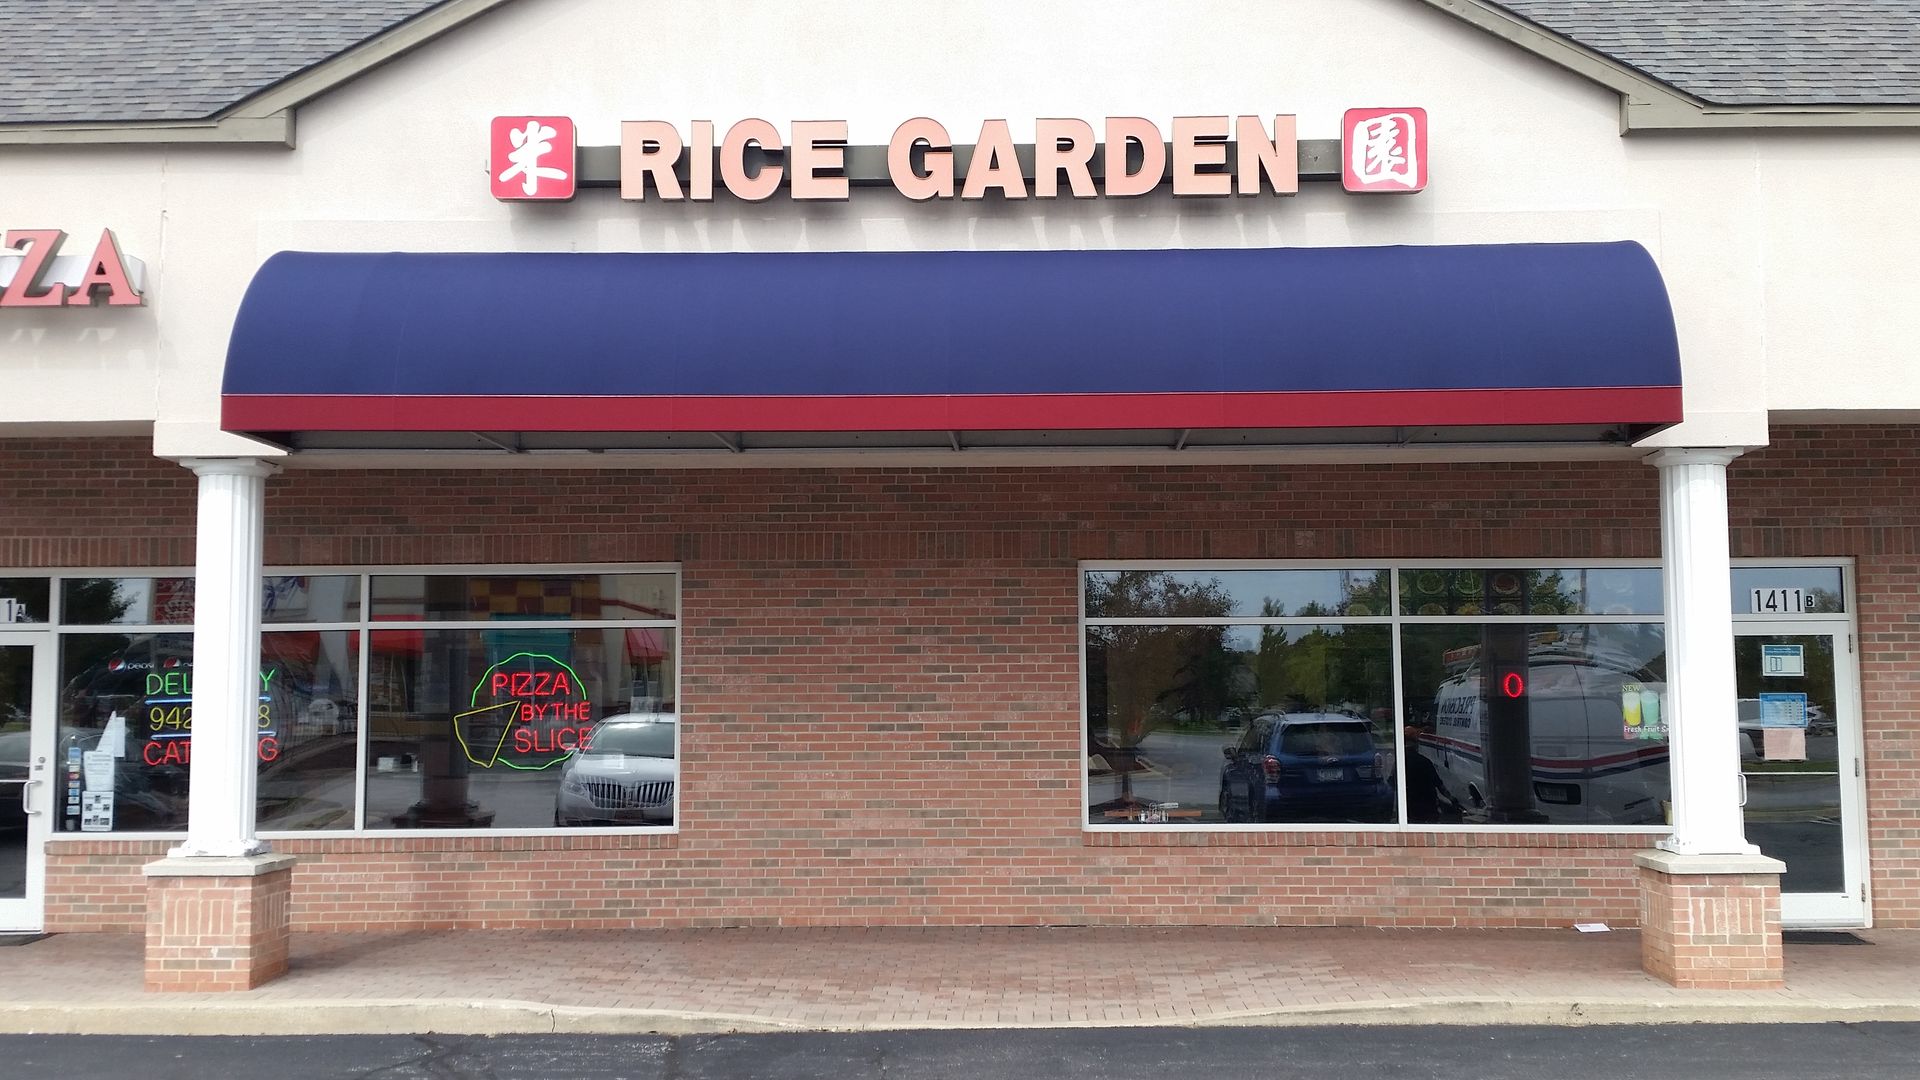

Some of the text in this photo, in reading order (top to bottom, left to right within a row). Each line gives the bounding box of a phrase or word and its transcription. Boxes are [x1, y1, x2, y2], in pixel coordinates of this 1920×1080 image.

[499, 120, 568, 197] 米
[620, 114, 1299, 201] RICE GARDEN
[0, 227, 143, 307] ZA
[1754, 589, 1814, 612] 1411 B
[145, 669, 276, 696] DELY
[492, 672, 570, 697] PIZZA
[1622, 684, 1641, 692] NEW
[521, 701, 591, 721] BY THE
[514, 727, 593, 753] SLICE
[1623, 725, 1642, 733] Fresh
[1643, 725, 1660, 733] Fruit
[143, 737, 279, 766] CATG
